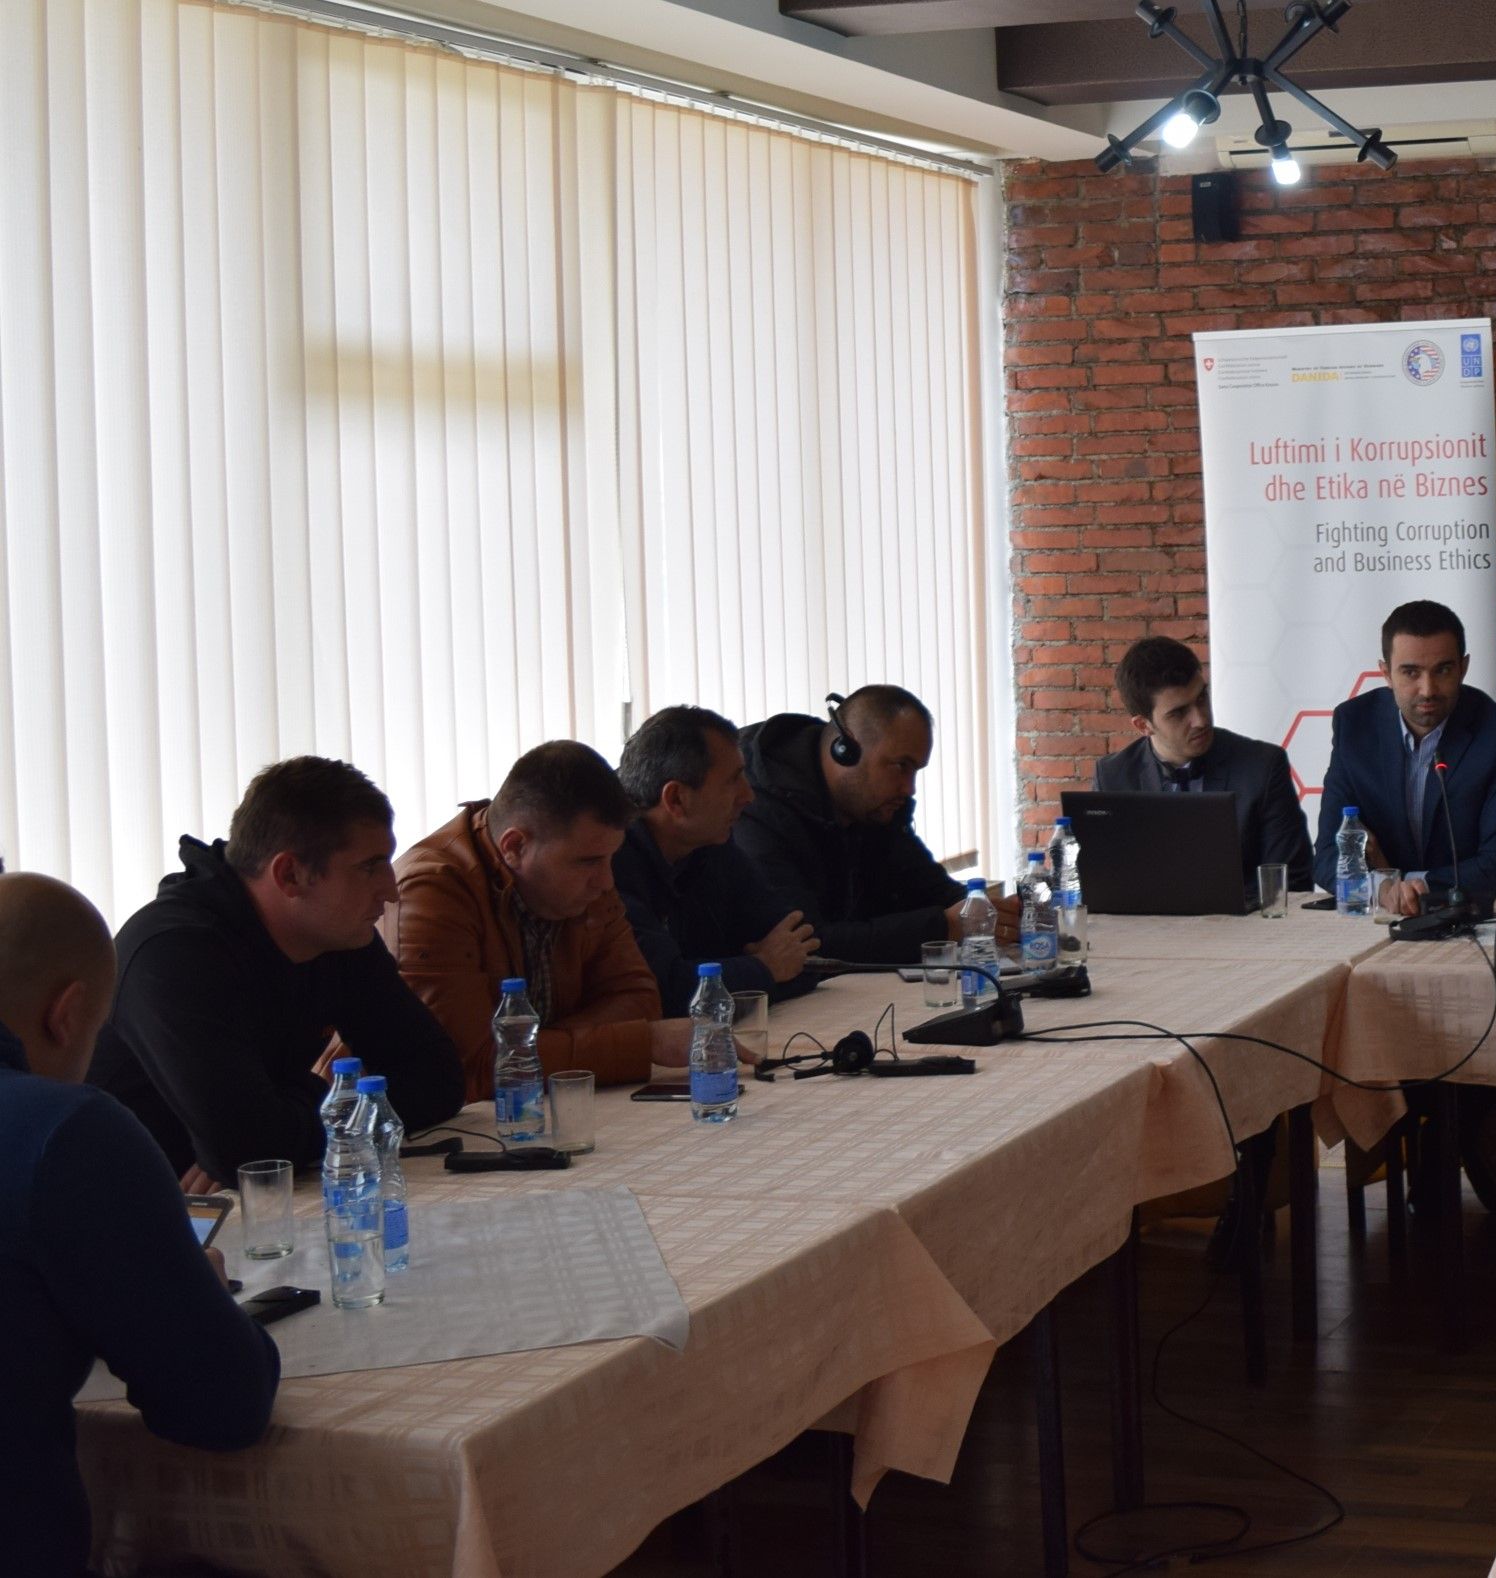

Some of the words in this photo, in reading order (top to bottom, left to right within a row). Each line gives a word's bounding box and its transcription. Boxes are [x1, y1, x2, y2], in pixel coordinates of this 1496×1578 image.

[1250, 437, 1326, 465] Luftimi
[1335, 437, 1341, 462] i
[1350, 432, 1488, 466] Korrupsionit
[1264, 475, 1305, 501] dhe
[1316, 472, 1368, 500] Etika
[1379, 474, 1405, 498] në
[1416, 471, 1488, 497] Biznes
[1316, 521, 1388, 548] Fighting
[1396, 519, 1490, 544] Corruption
[1314, 552, 1346, 573] and
[1354, 551, 1432, 572] Business
[1440, 548, 1491, 570] Ethics
